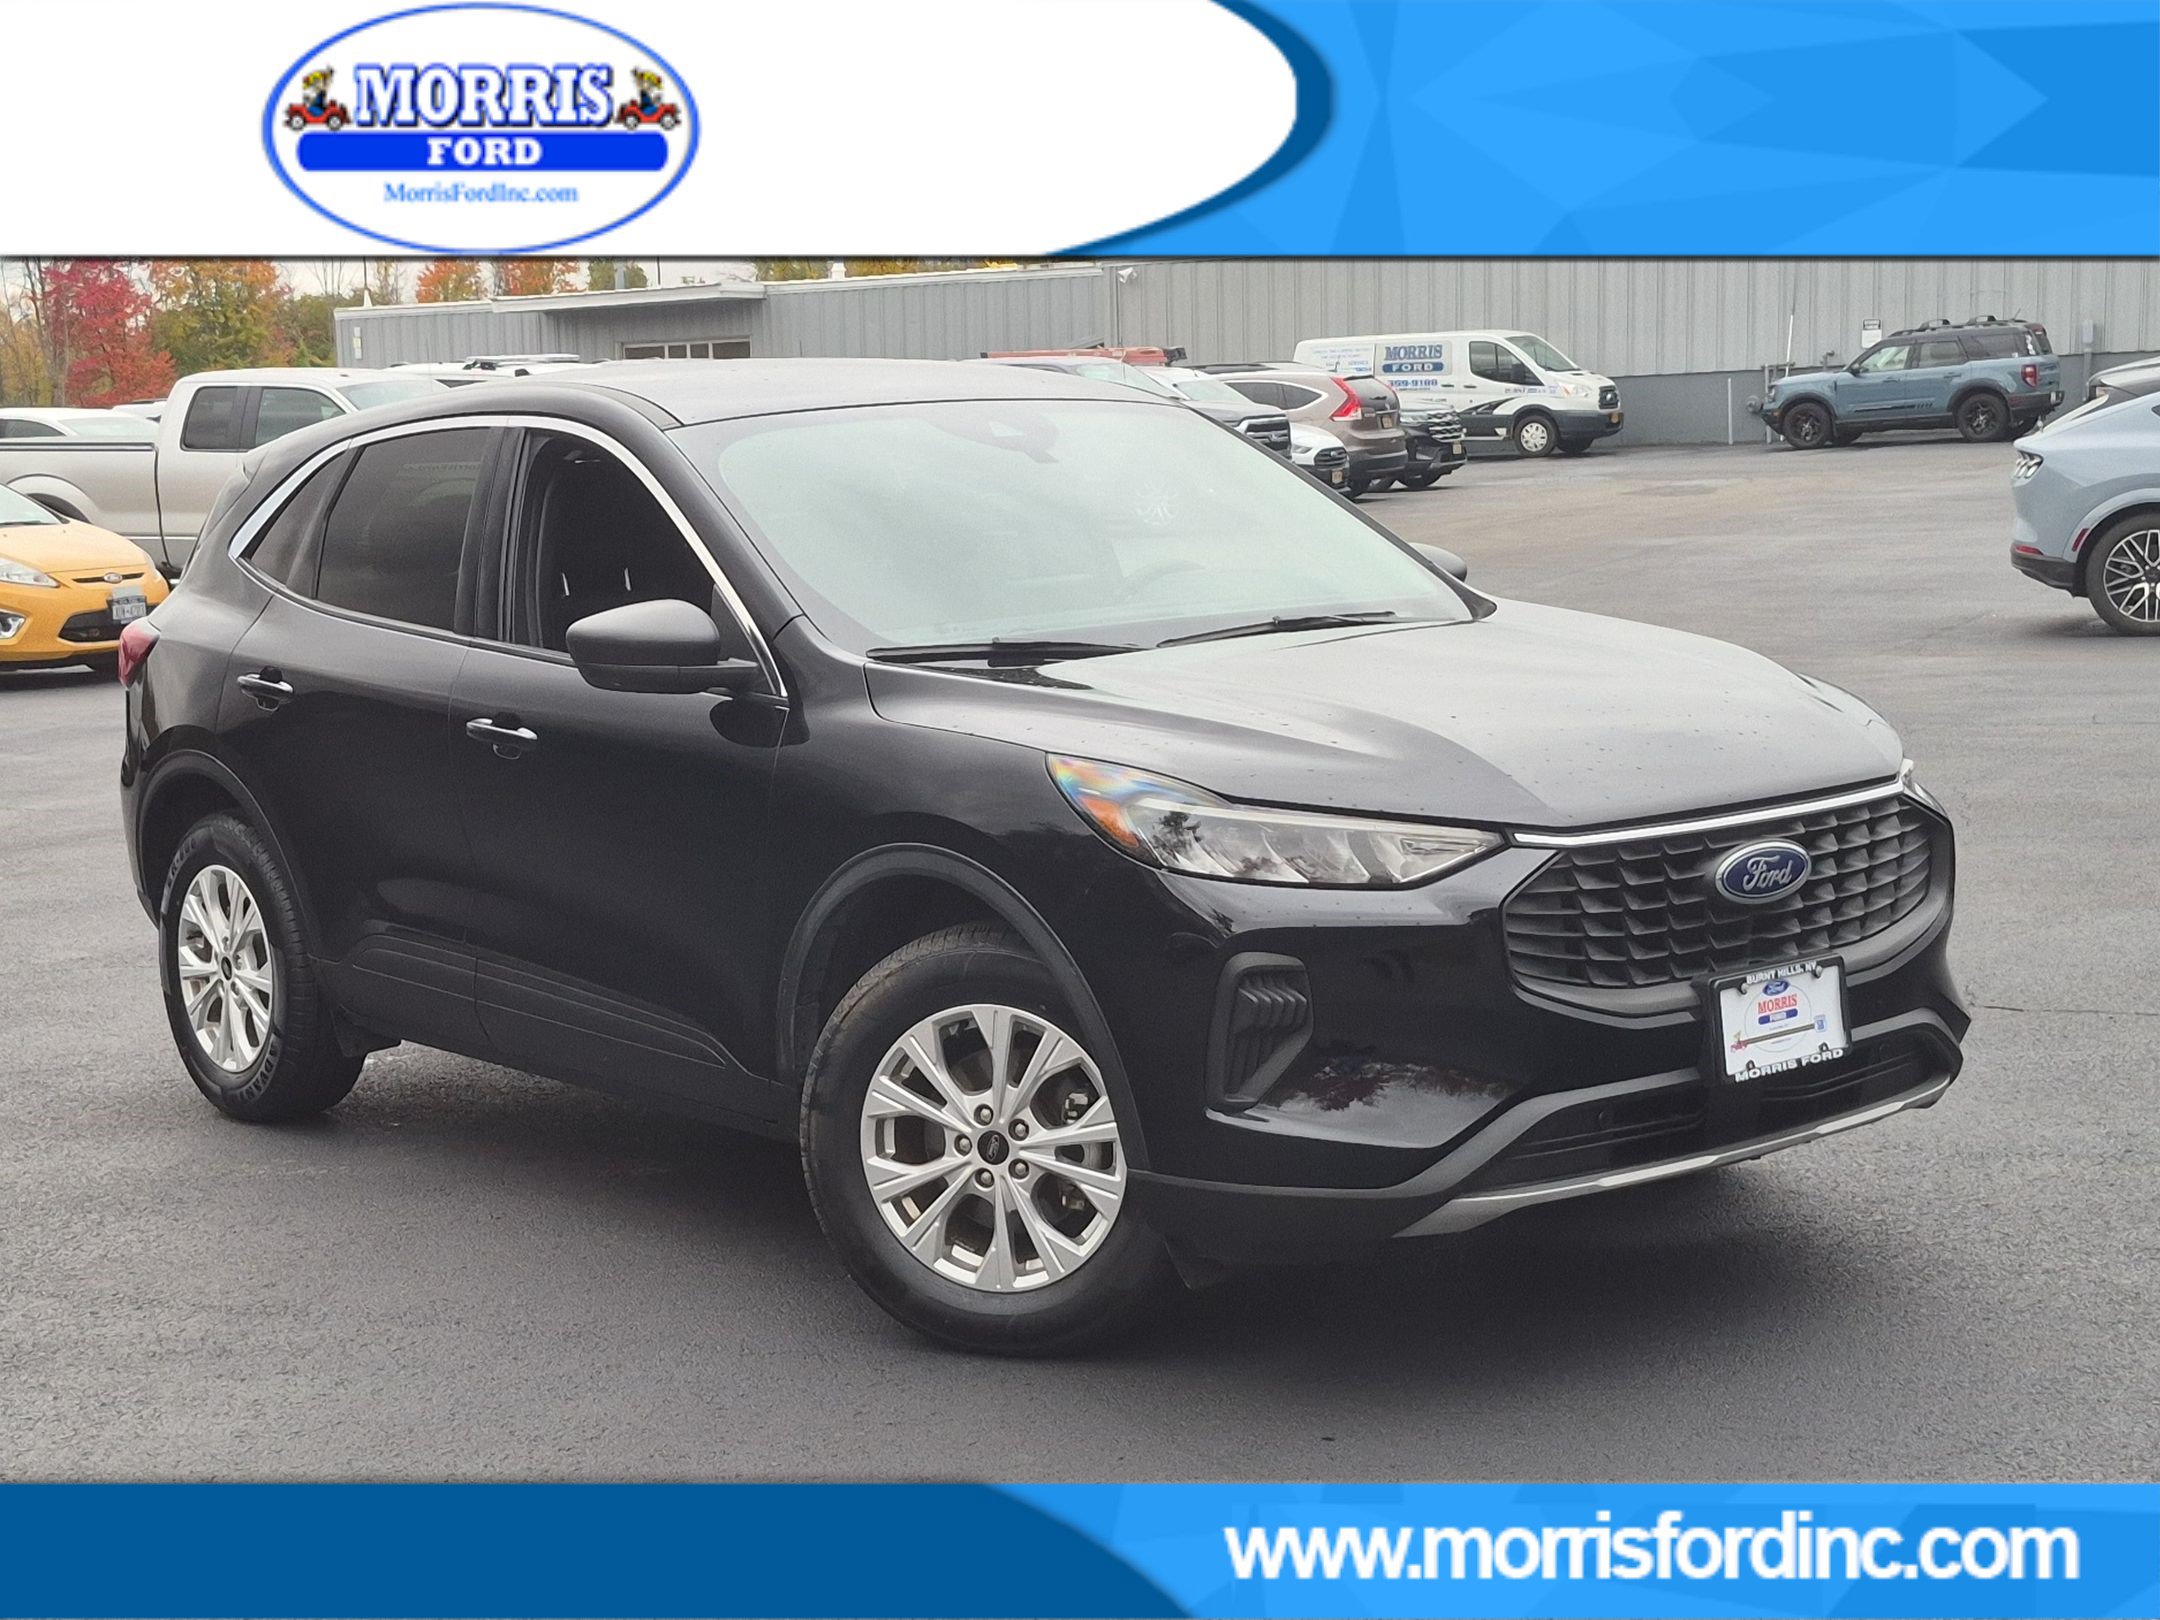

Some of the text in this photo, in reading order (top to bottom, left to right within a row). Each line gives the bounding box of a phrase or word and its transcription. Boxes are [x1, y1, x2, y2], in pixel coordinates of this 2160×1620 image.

[1384, 344, 1443, 361] MORRIS
[1392, 362, 1433, 372] FORD
[1742, 855, 1793, 892] Ford
[1758, 994, 1798, 1014] MORRIS
[1734, 1049, 1844, 1083] MORRIS FORD
